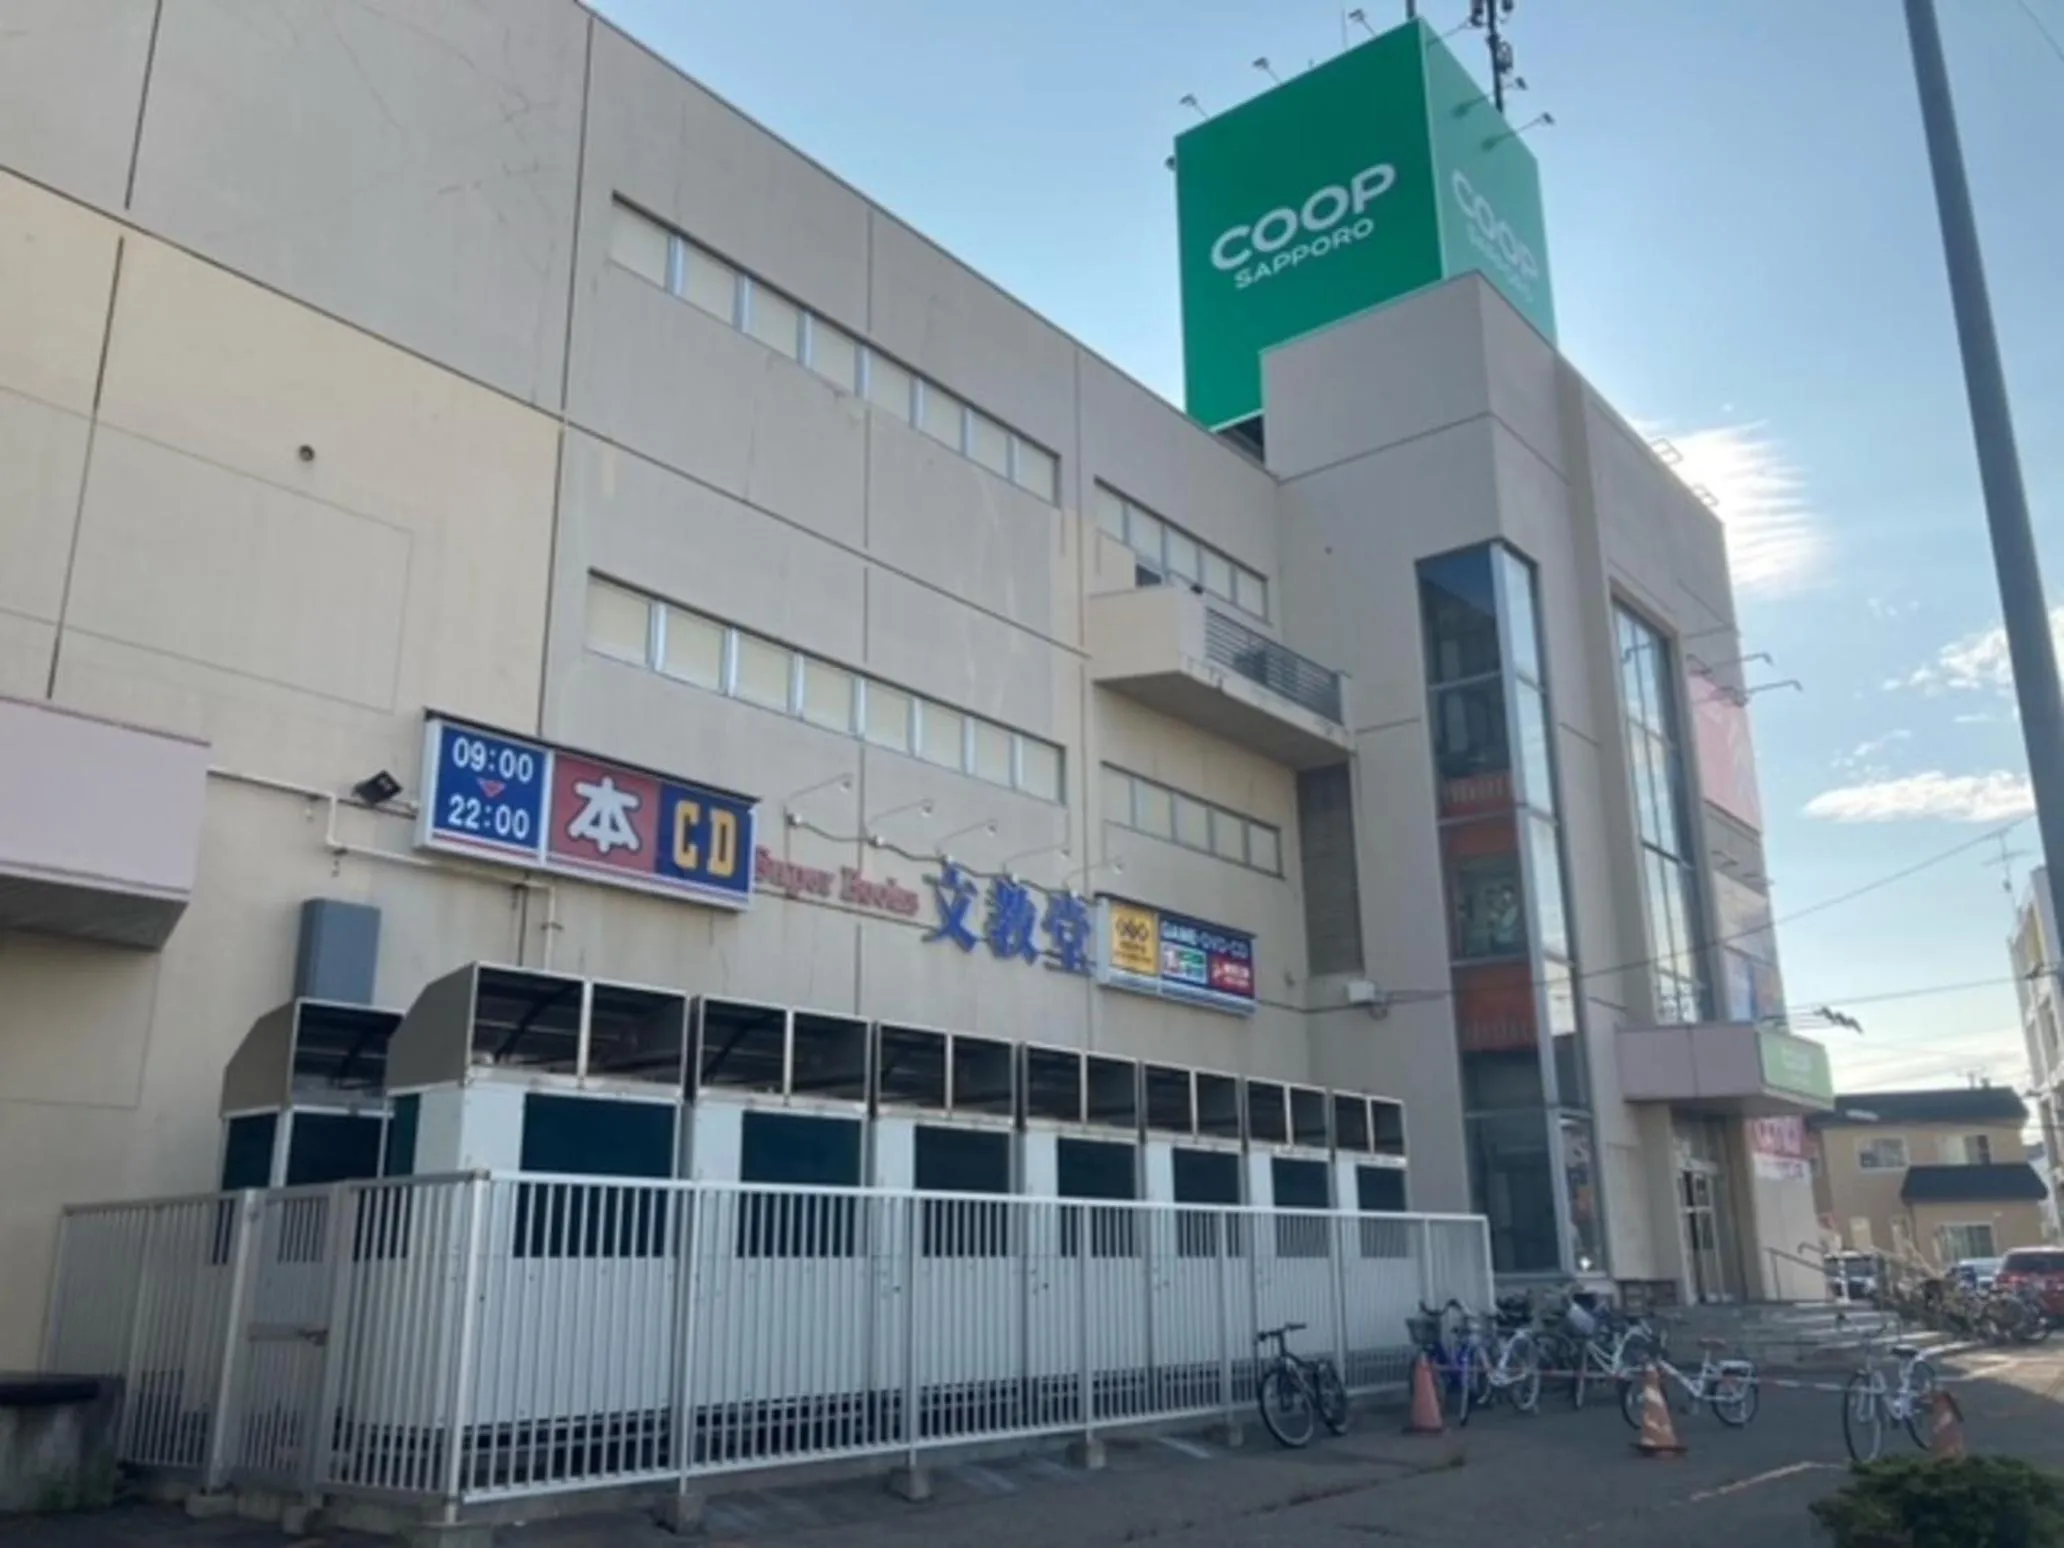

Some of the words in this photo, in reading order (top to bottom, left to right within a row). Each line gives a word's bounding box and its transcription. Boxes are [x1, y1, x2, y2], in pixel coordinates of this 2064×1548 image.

[1210, 162, 1396, 271] COOP
[1234, 217, 1374, 290] SAPPORO
[452, 736, 534, 783] 09:00
[447, 795, 531, 840] 22:00
[568, 776, 641, 853] 本
[672, 799, 738, 878] CD
[921, 860, 1095, 977] 文教堂
